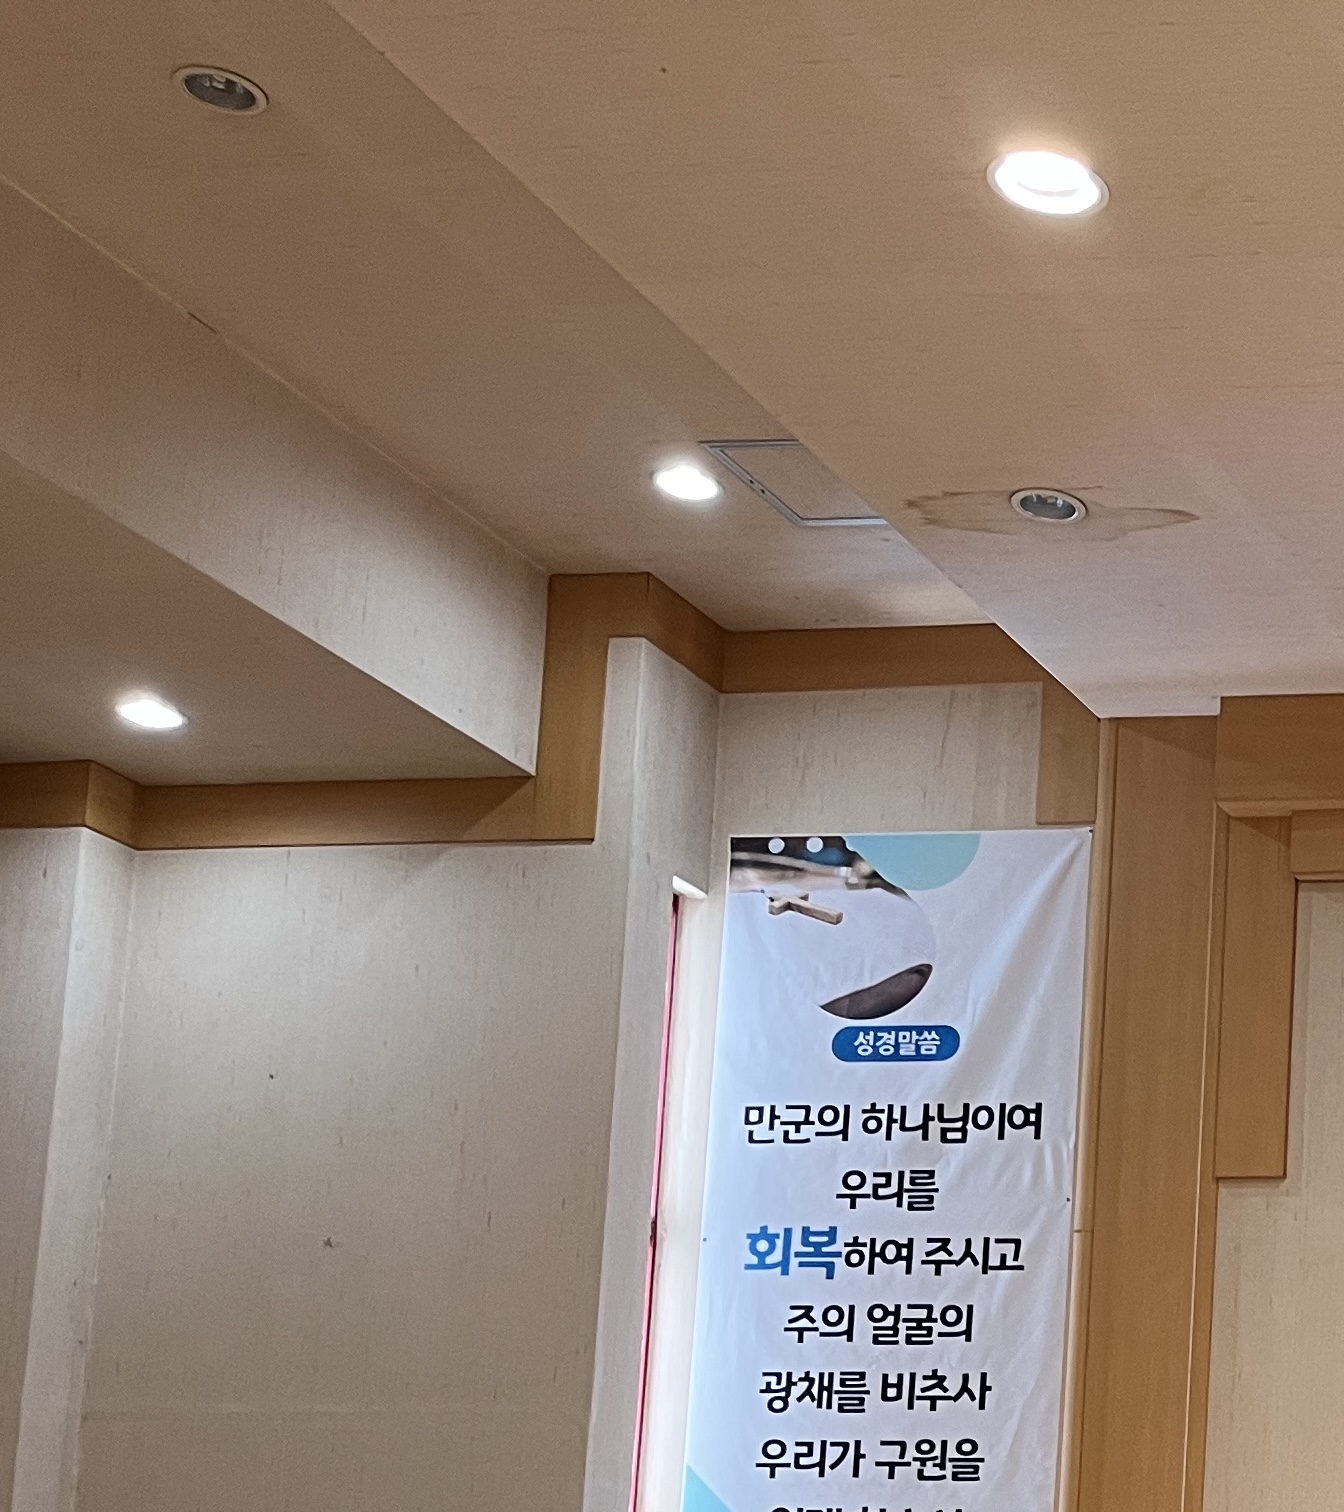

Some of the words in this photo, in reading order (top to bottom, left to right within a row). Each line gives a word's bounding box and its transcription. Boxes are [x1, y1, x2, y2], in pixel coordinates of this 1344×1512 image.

[853, 1030, 941, 1056] 성경말씀
[743, 1104, 851, 1145] 만군의
[861, 1101, 1043, 1144] 하나님이여
[835, 1169, 940, 1212] 우리를
[920, 1236, 1025, 1277] 주시고
[783, 1304, 856, 1344] 주의
[866, 1303, 974, 1346] 얼굴의
[758, 1370, 871, 1414] 광채를
[880, 1368, 993, 1412] 비추사
[755, 1438, 867, 1479] 우리가
[874, 1438, 986, 1482] 구원을
